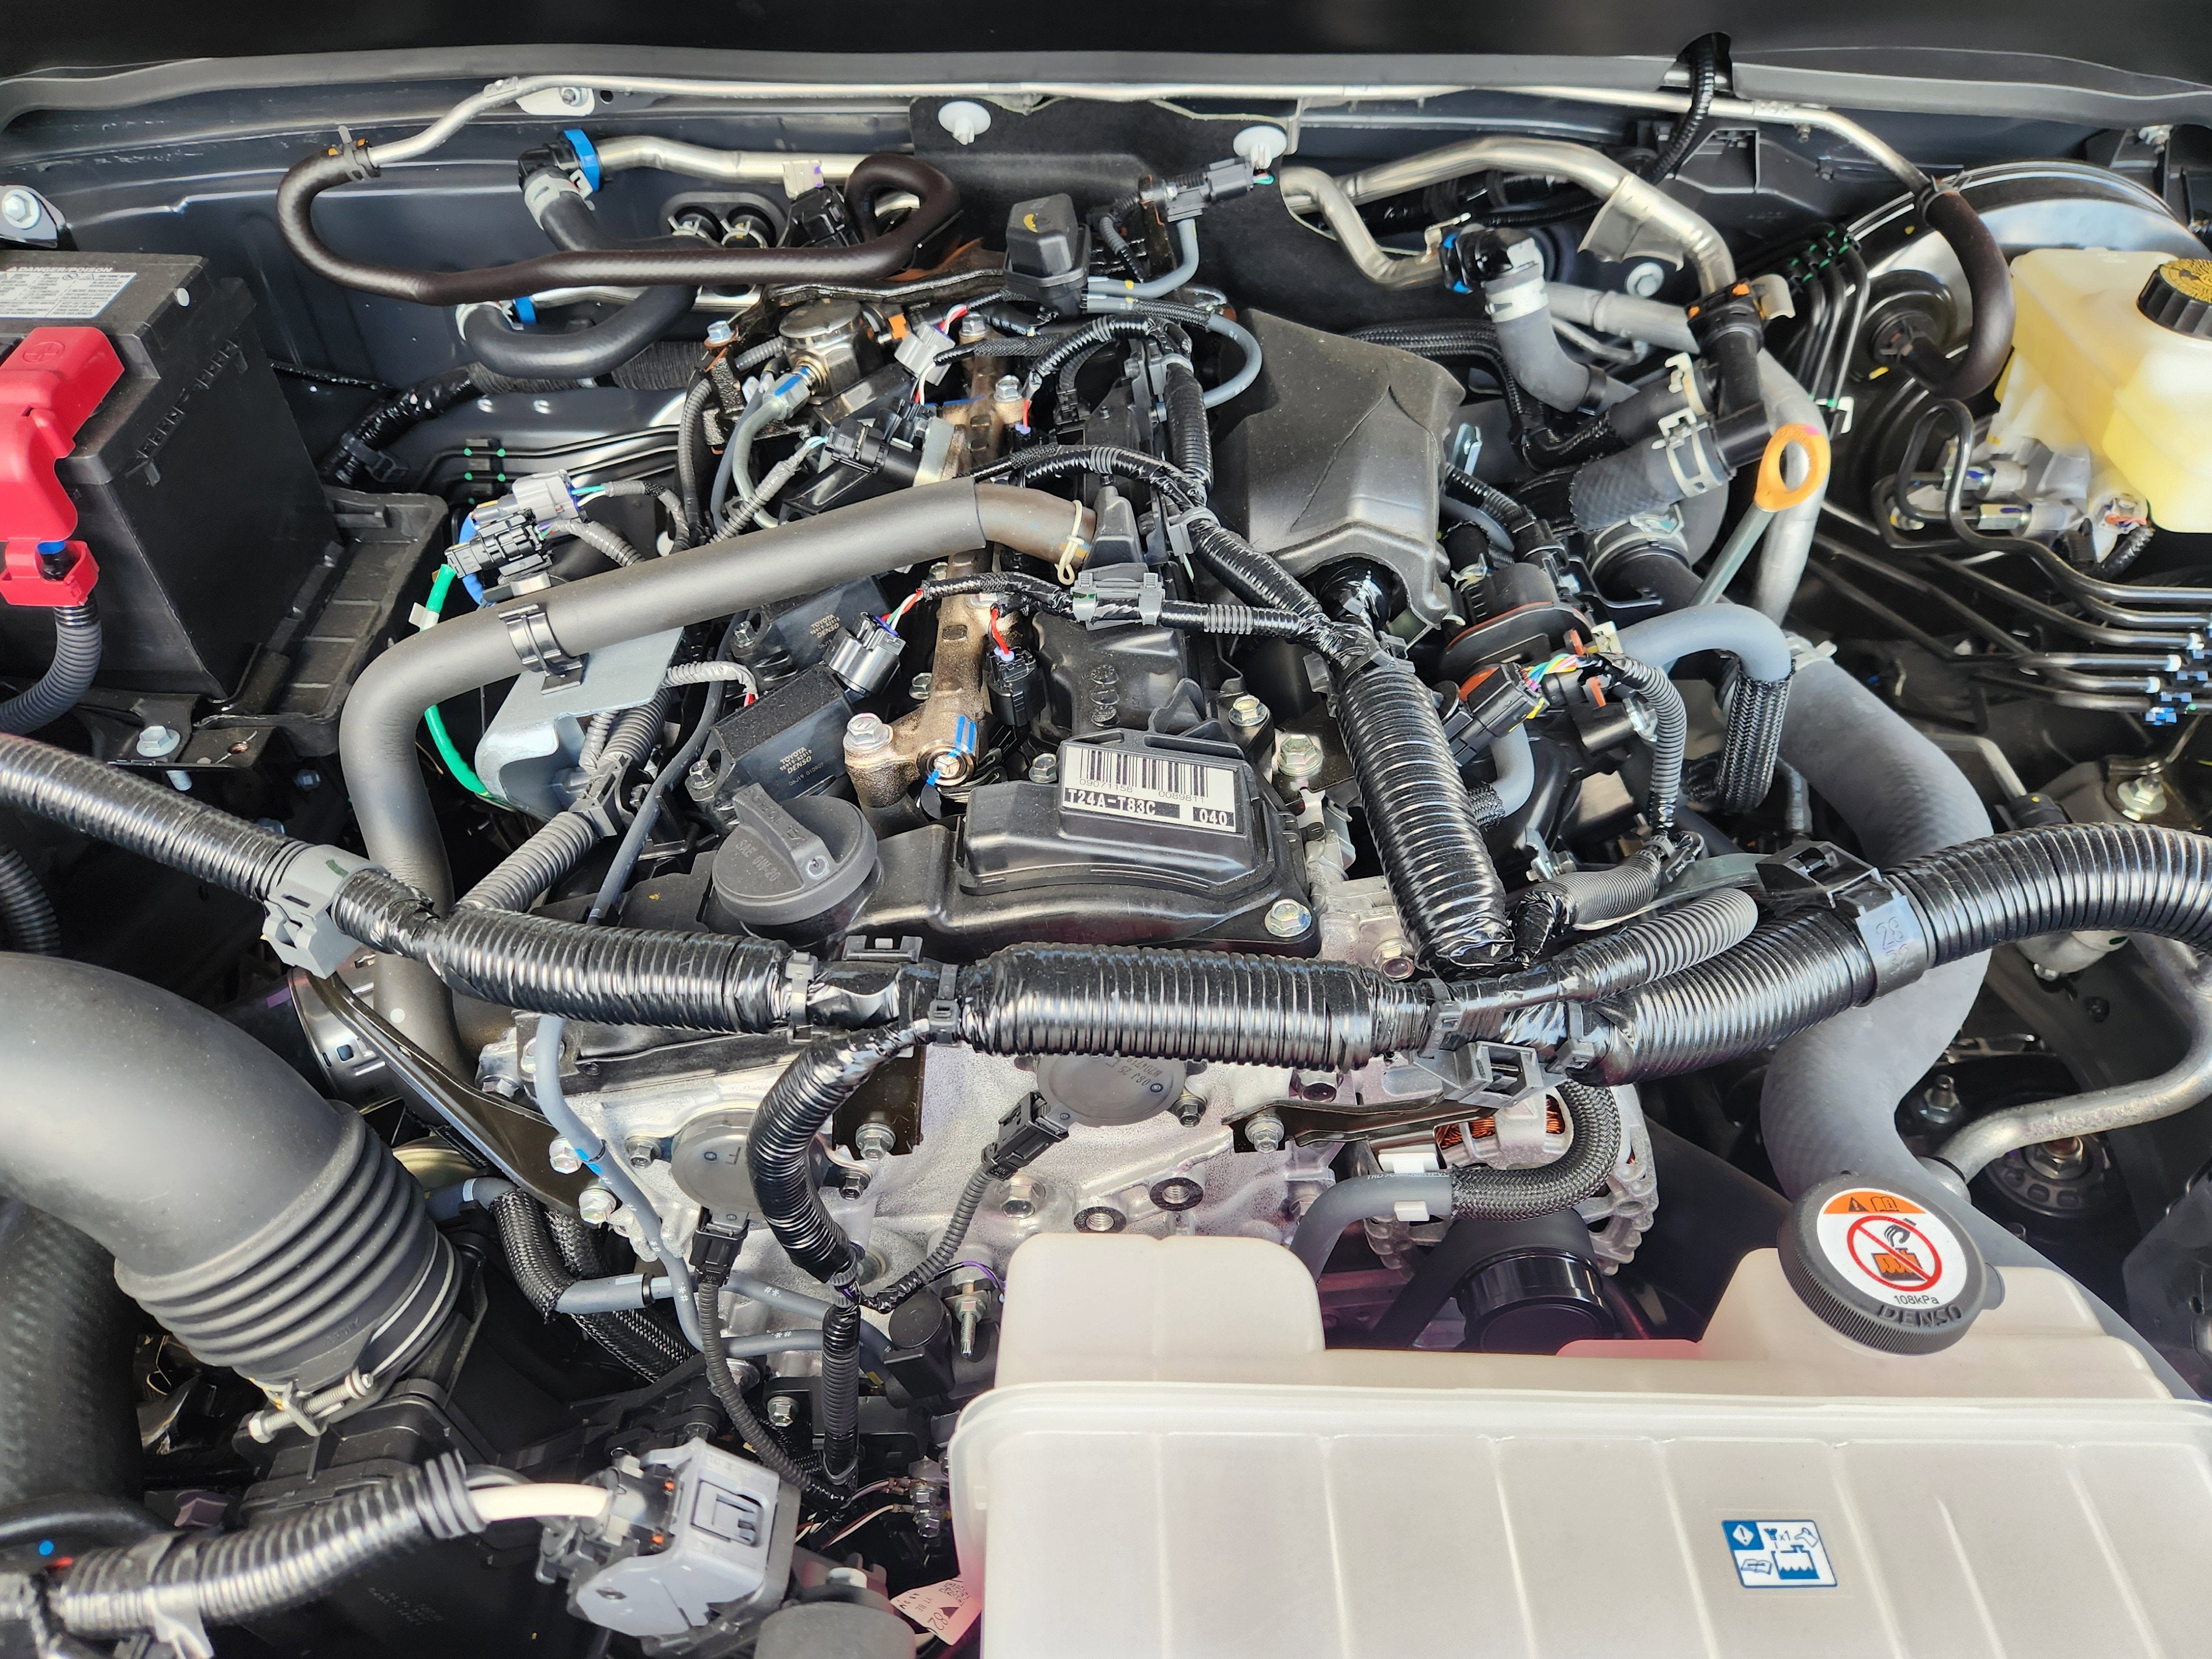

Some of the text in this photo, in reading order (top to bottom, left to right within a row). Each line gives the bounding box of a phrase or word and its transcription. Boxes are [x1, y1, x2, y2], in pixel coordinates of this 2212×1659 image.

[810, 614, 835, 629] TOYOTA
[817, 623, 839, 638] DENSO
[780, 747, 807, 764] TOYOTA
[786, 756, 812, 774] DENSO
[1079, 779, 1204, 803] 09071158 0089811
[1068, 789, 1227, 826] T24A-T83C 040
[735, 840, 781, 881] SAE 0W-20
[1876, 916, 1904, 950] 28
[1894, 1295, 1939, 1305] 108kPa
[1877, 1303, 1963, 1328] DENSO
[927, 1612, 948, 1631] 82
